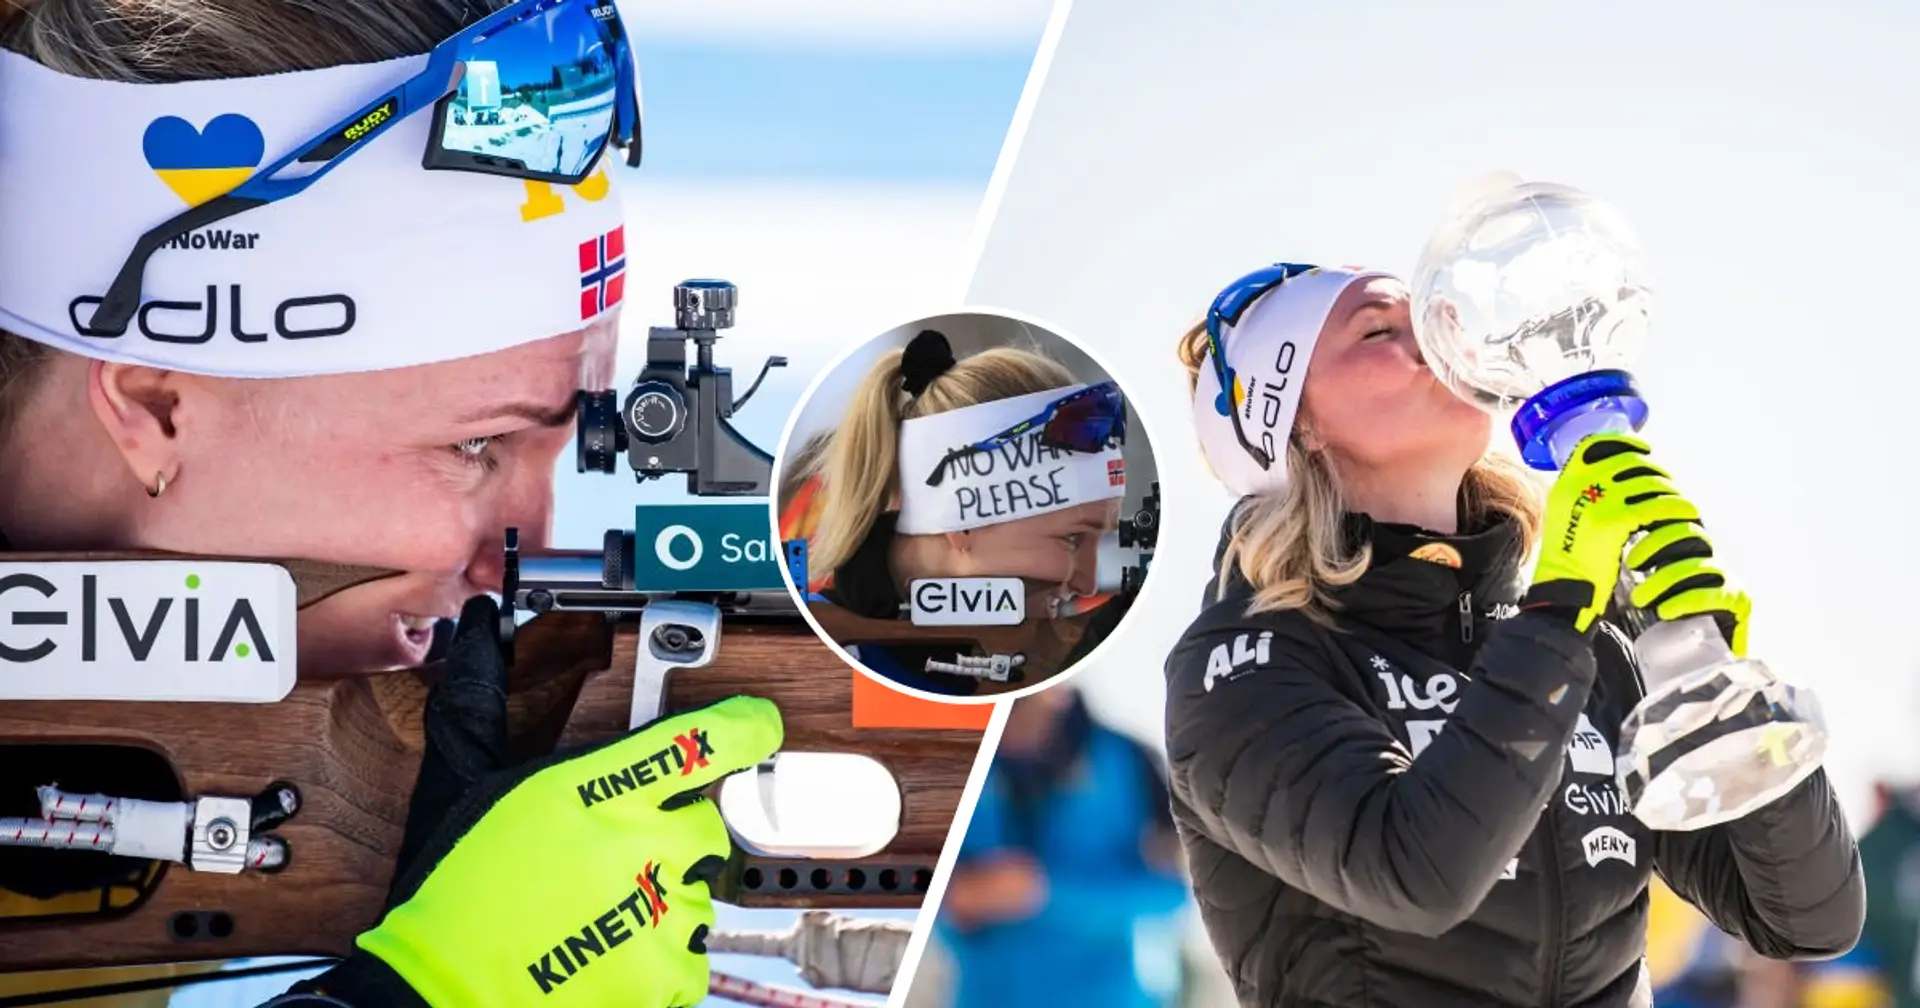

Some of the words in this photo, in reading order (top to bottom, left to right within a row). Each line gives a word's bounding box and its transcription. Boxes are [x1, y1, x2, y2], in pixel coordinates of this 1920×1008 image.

[344, 103, 391, 139] RUDY
[162, 229, 260, 250] NoWar
[68, 284, 357, 345] odlo
[947, 444, 994, 480] NO
[955, 466, 1070, 521] PLEASE
[1563, 483, 1606, 553] KINETIXX
[577, 727, 715, 808] KINETIXX
[1589, 835, 1629, 857] MENY
[527, 860, 669, 995] KINETIXX
